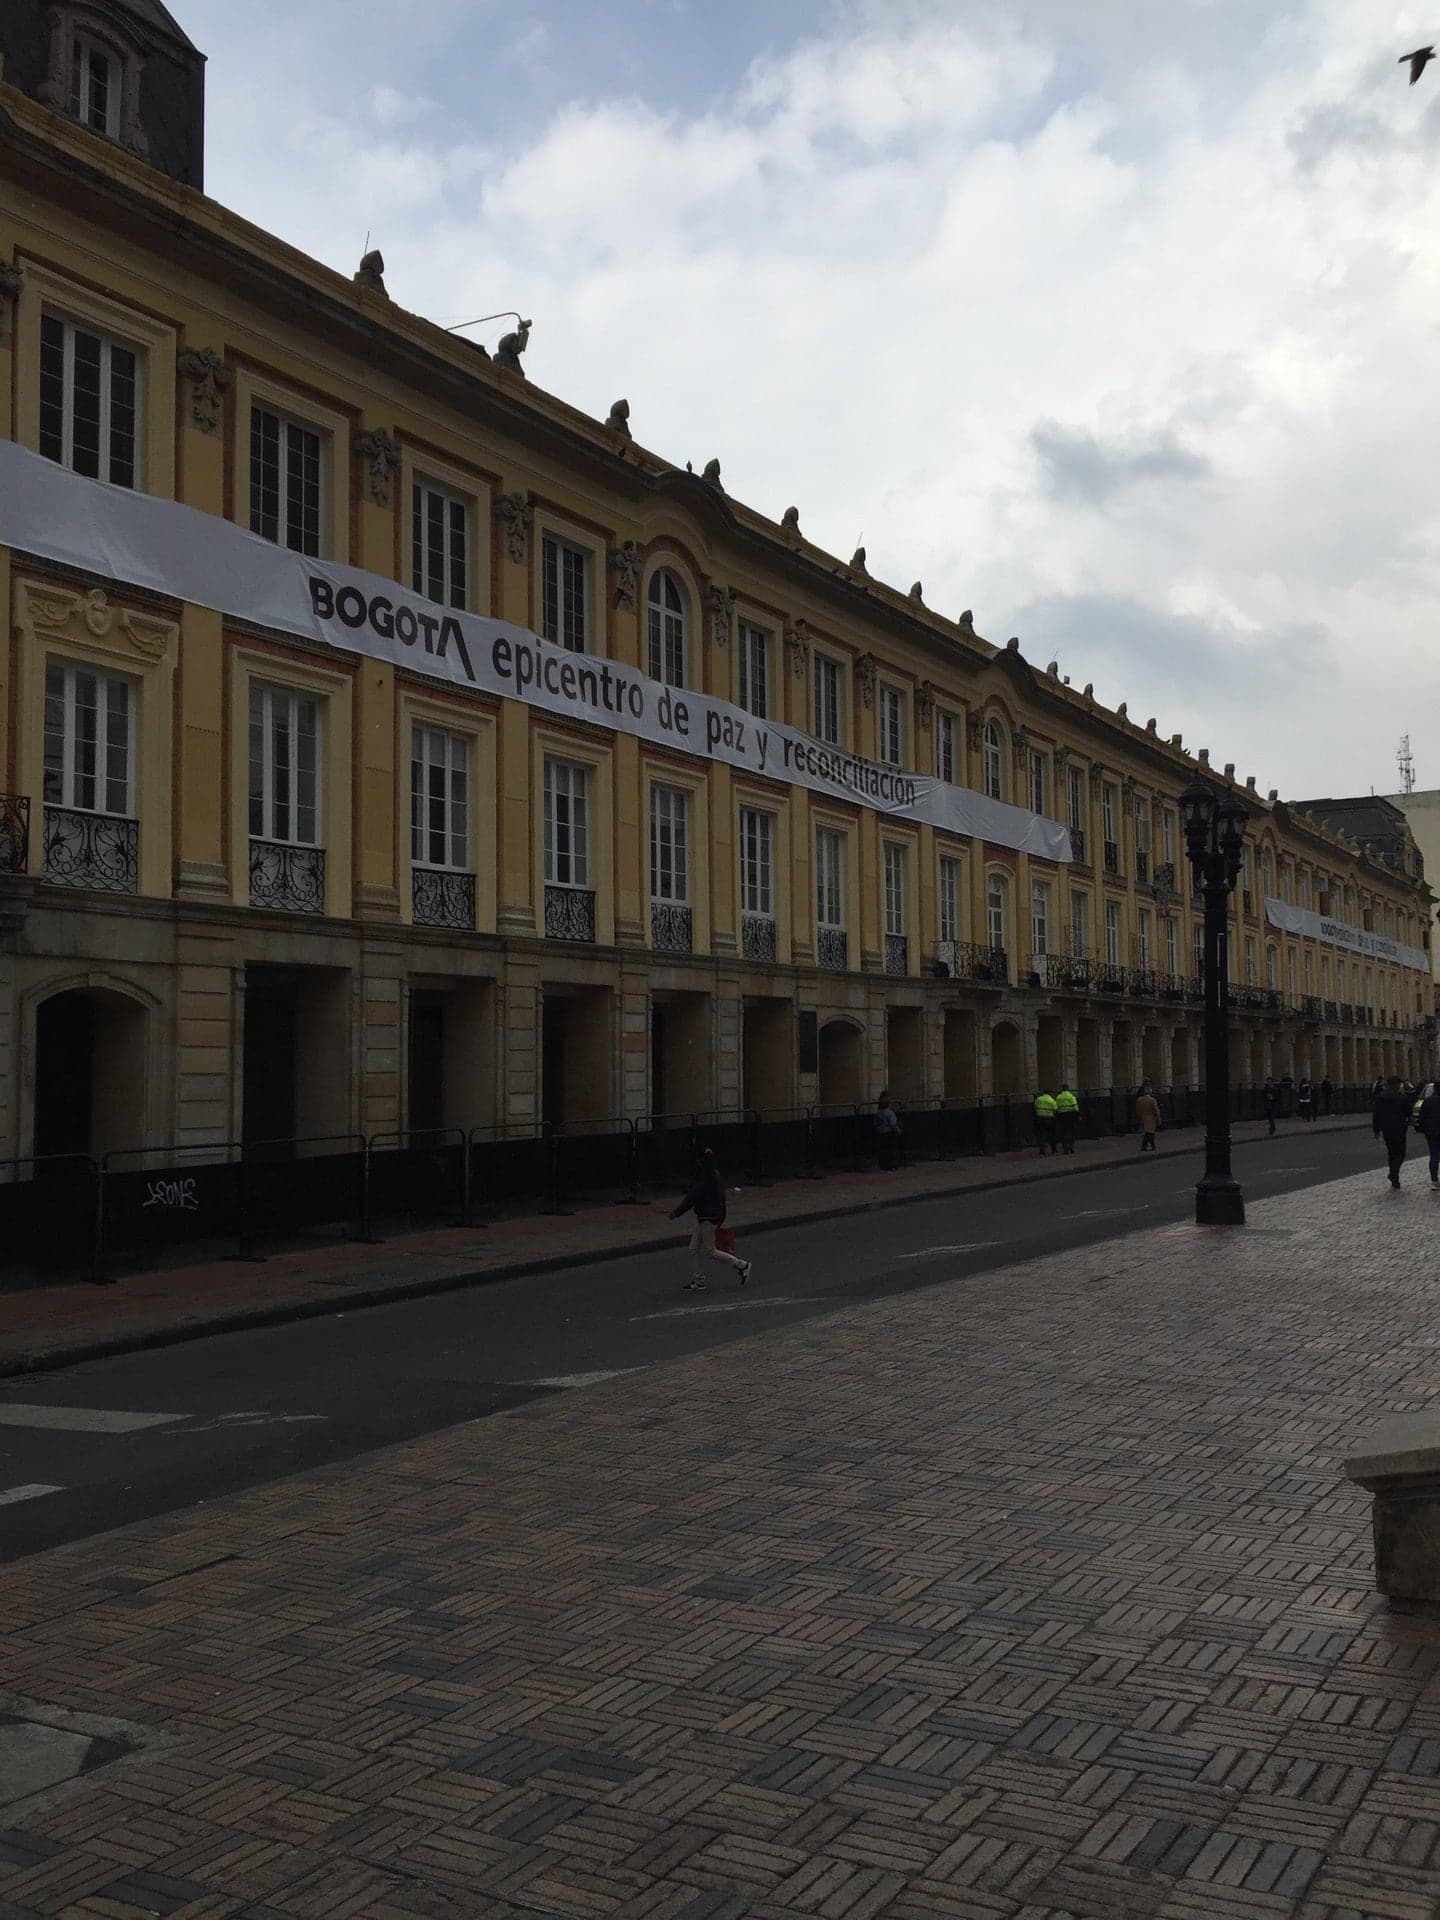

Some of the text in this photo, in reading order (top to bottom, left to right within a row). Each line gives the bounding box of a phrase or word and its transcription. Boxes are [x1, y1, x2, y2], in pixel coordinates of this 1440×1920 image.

[492, 637, 644, 718] epicentro
[658, 687, 689, 735] de
[706, 710, 746, 754] paz
[756, 729, 768, 770] y
